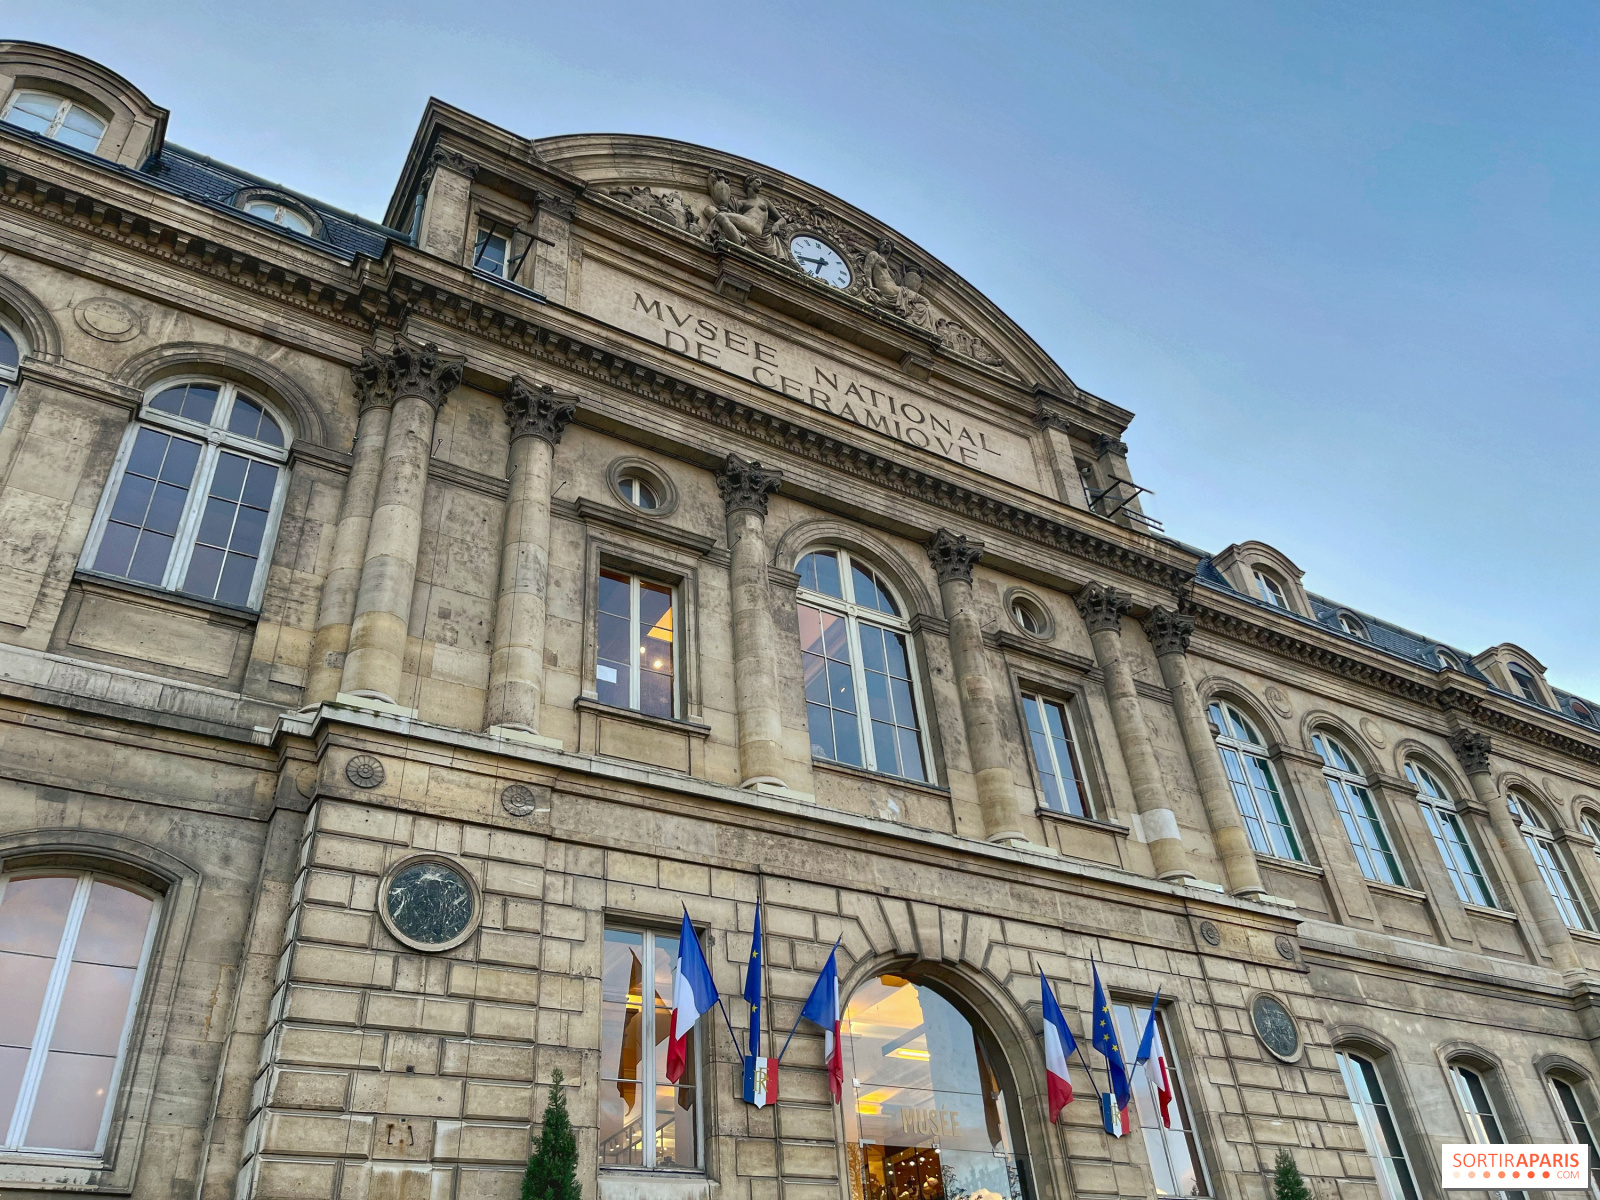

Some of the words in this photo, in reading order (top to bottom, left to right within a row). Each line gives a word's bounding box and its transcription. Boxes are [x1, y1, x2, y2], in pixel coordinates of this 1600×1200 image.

[632, 291, 779, 368] MVSEE
[814, 366, 1002, 456] NATIONAL
[664, 328, 722, 369] DE
[752, 366, 981, 470] CERAMIQVE
[901, 1104, 962, 1137] MUSÉE
